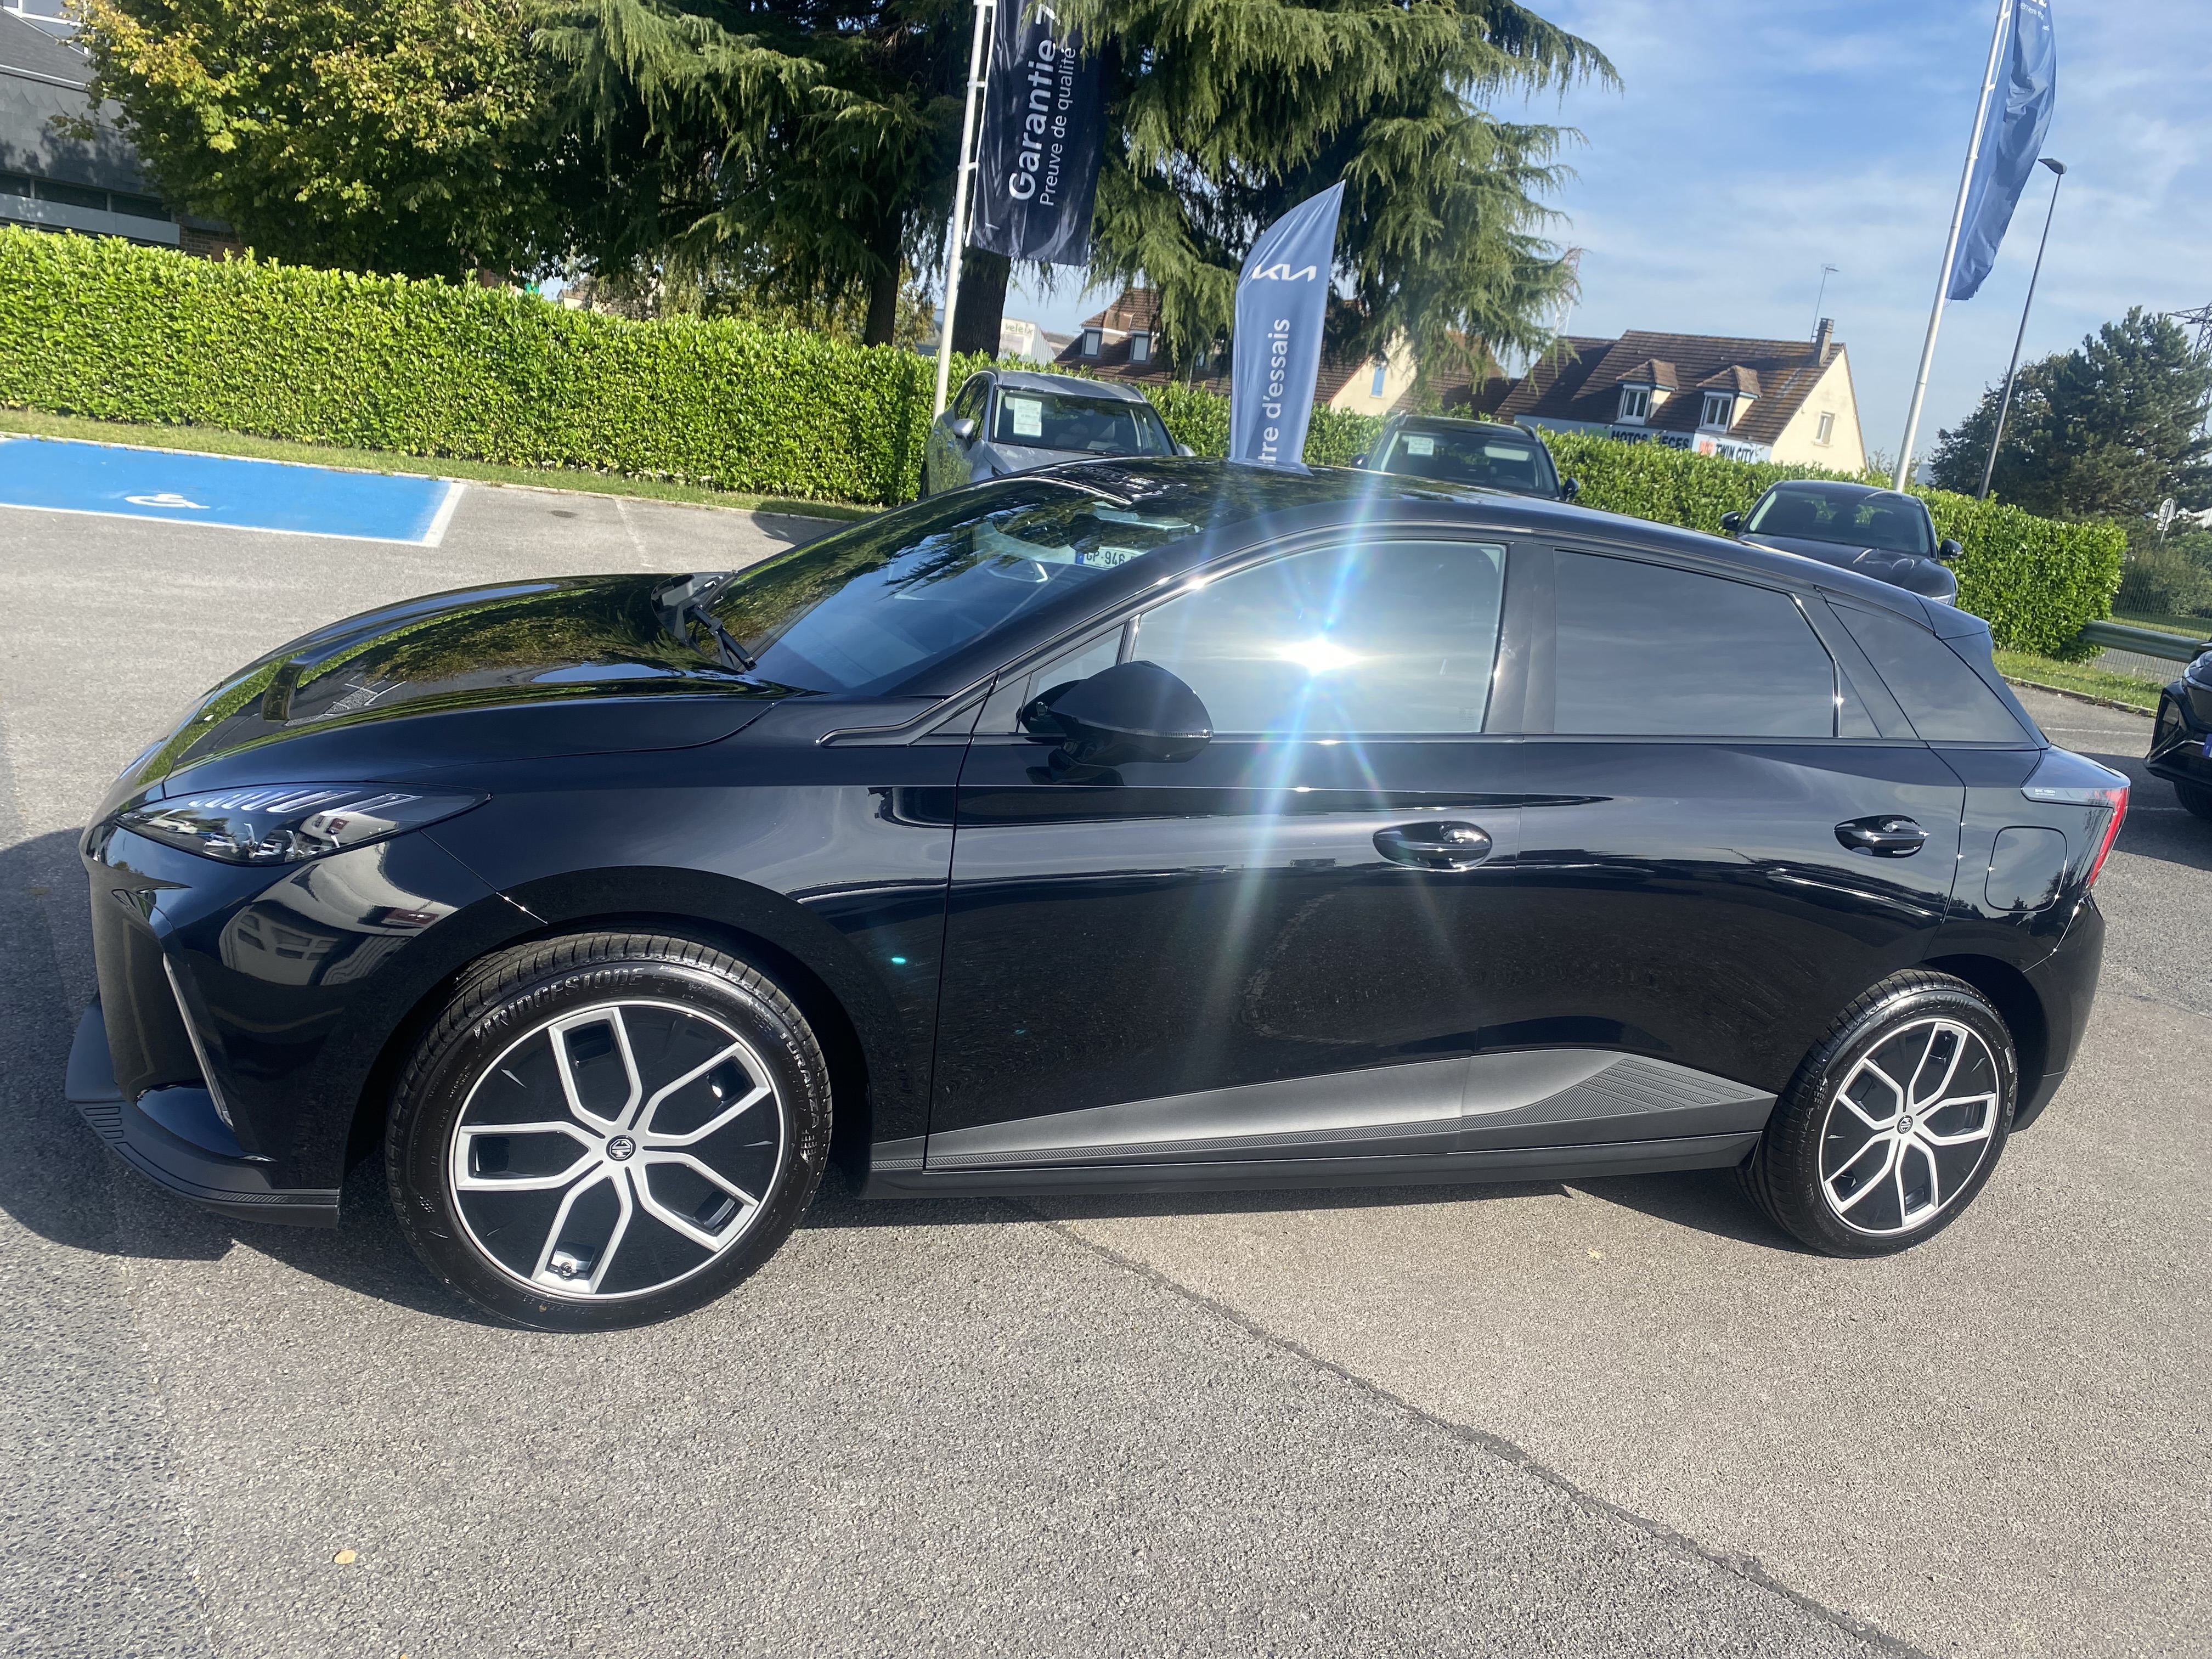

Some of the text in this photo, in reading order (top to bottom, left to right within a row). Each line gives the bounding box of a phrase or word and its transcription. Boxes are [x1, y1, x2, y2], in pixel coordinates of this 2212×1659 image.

[1009, 40, 1056, 200] Garantie
[1040, 47, 1076, 206] Preuve de qualité
[1257, 319, 1290, 464] tre d'essais
[1736, 447, 1754, 463] CITY
